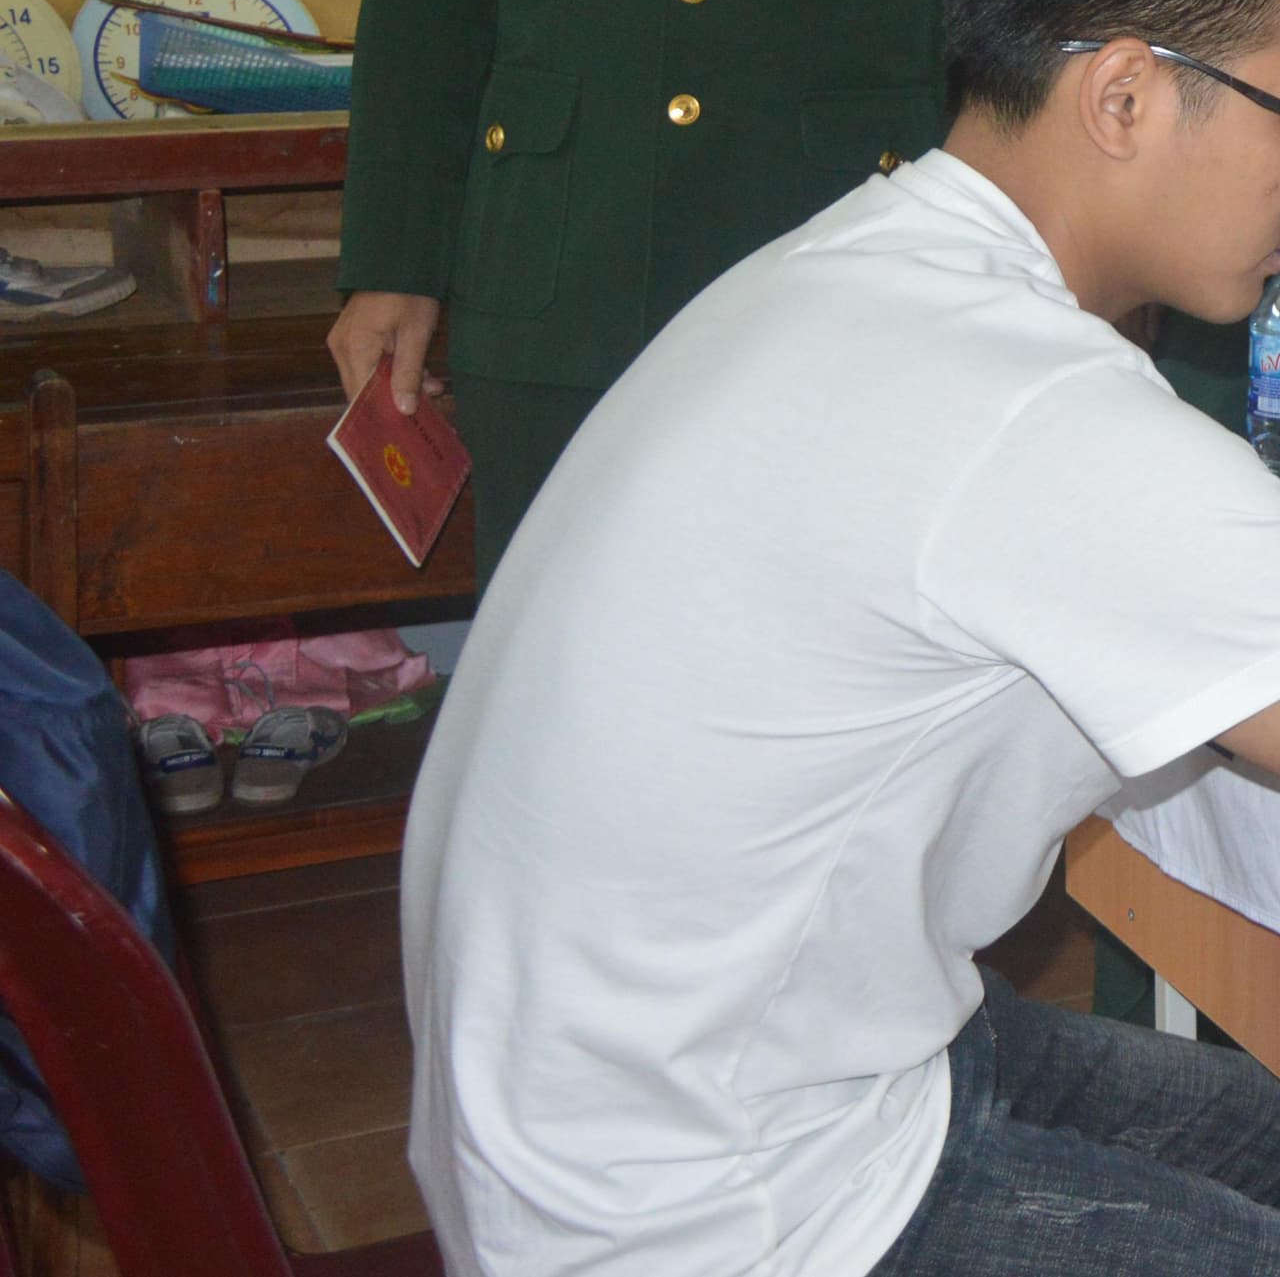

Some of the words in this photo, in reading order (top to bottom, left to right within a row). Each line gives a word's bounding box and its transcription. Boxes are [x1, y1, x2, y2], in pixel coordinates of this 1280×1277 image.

[8, 7, 32, 25] 14
[125, 22, 141, 37] 10
[37, 55, 61, 75] 15
[116, 55, 126, 69] 9
